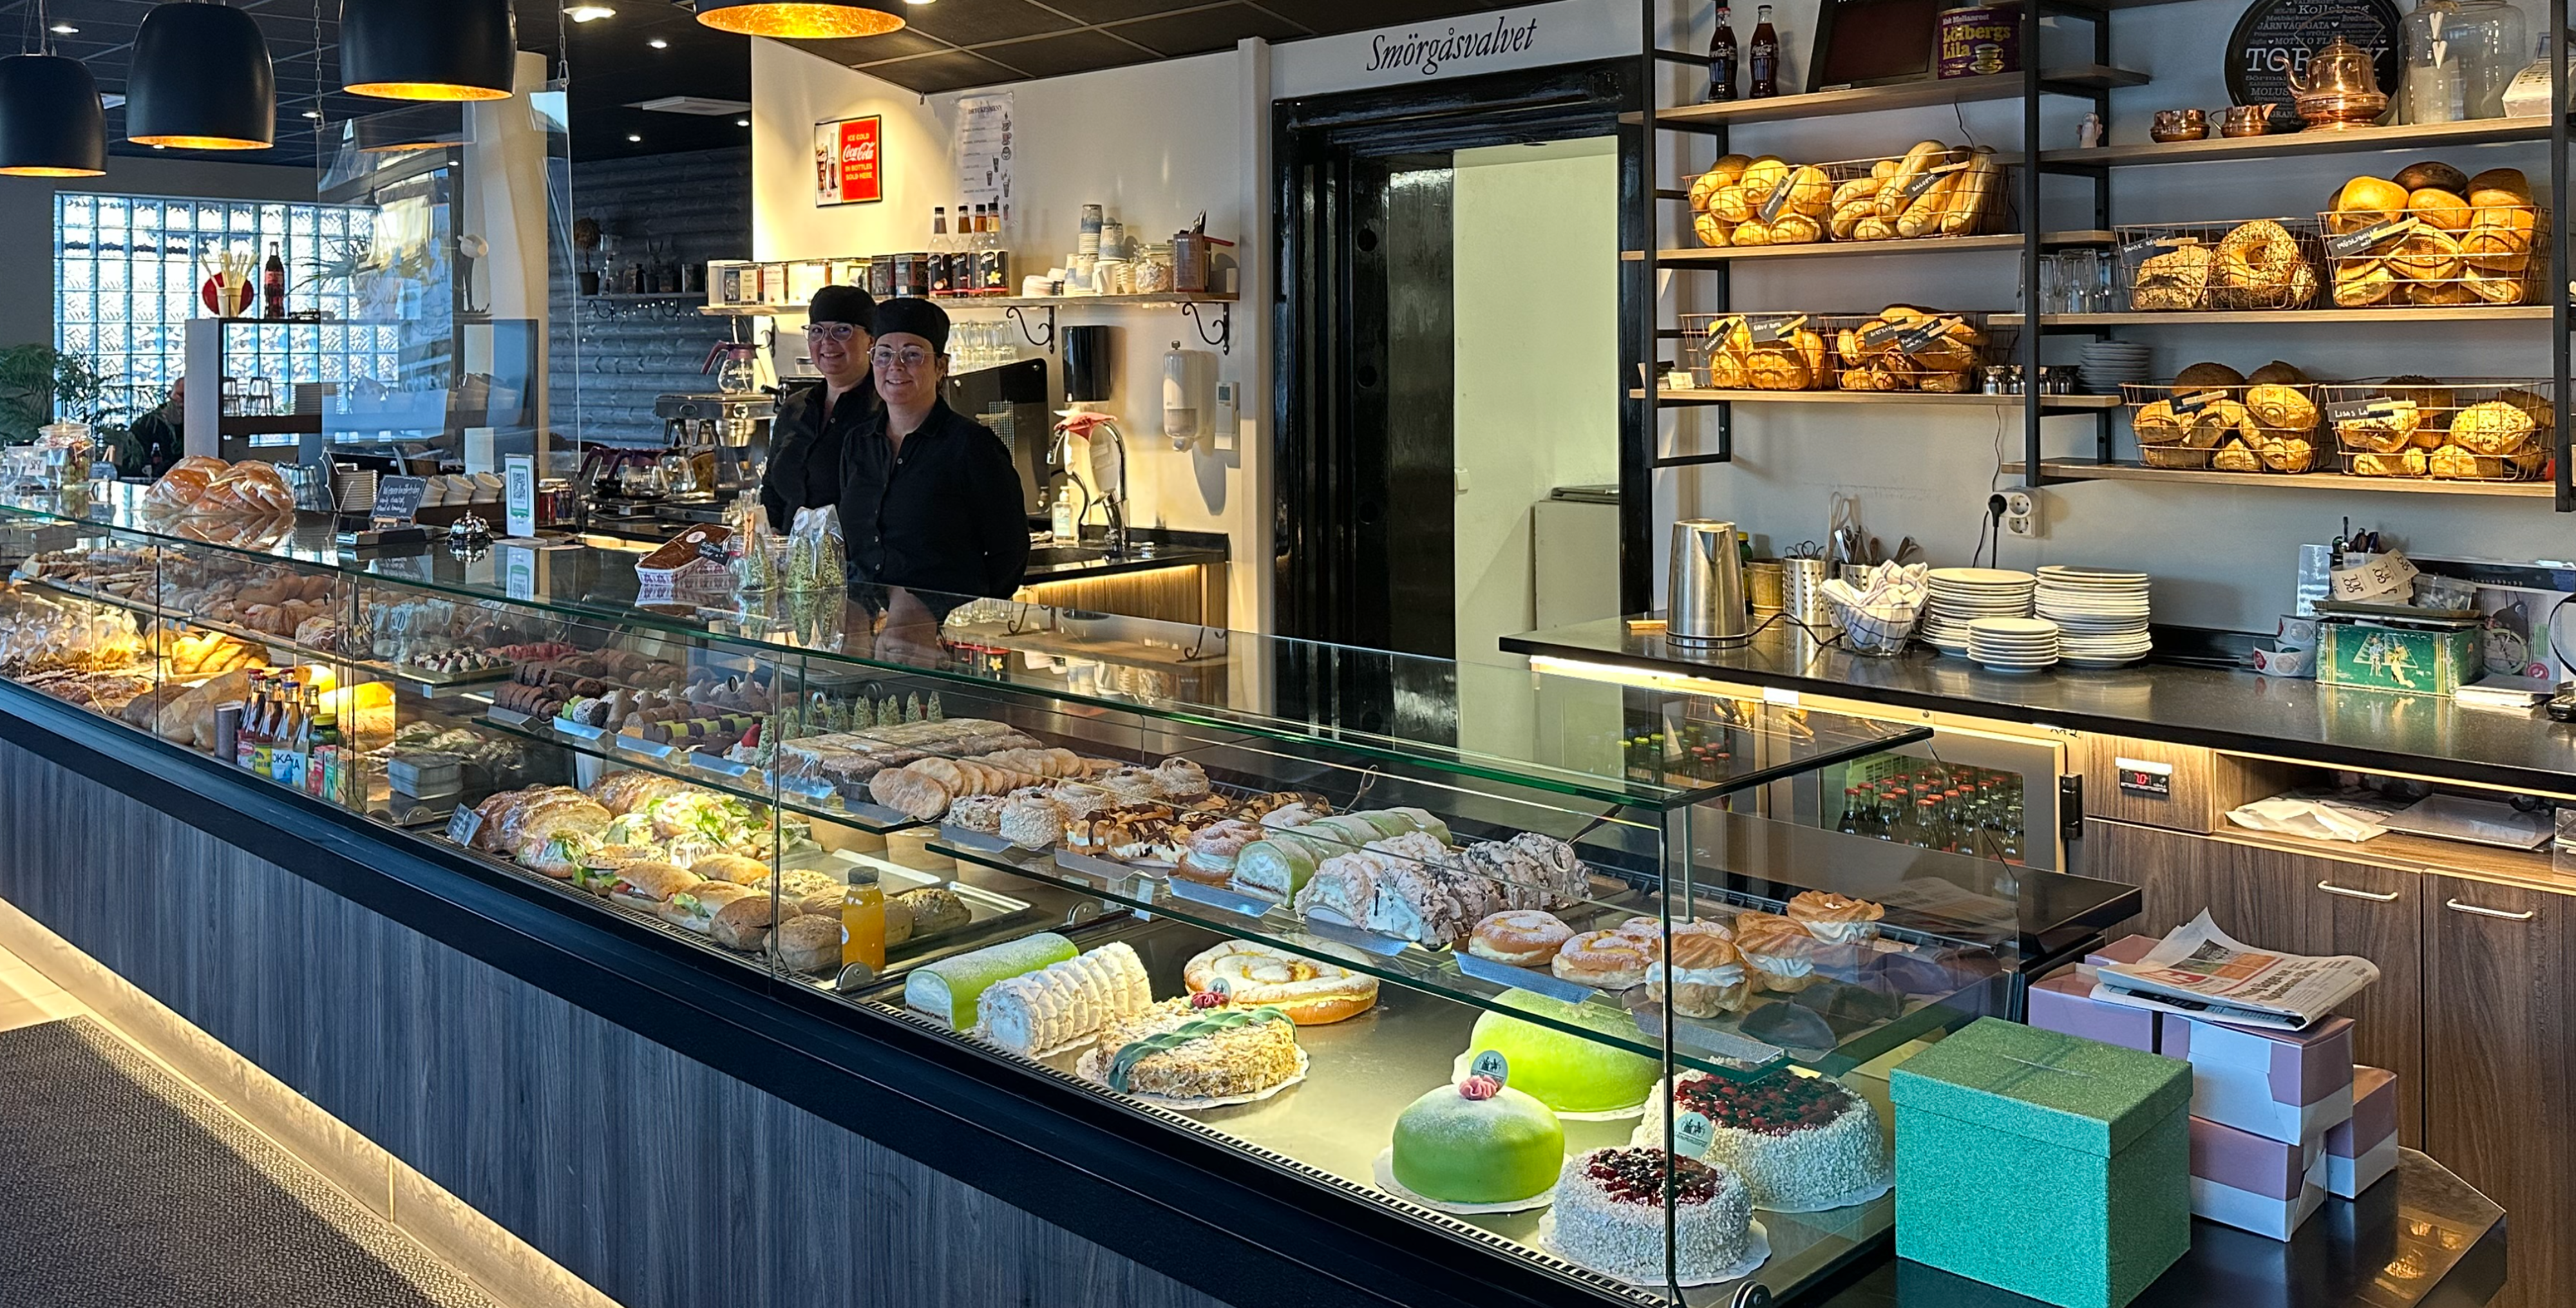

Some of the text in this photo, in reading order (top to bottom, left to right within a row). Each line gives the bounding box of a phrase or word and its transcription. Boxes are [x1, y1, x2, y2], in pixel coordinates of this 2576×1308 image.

[1943, 24, 2011, 43] Löfbergs
[1366, 16, 1537, 75] Smörgåsvalvet
[1943, 41, 1970, 60] Lila
[2246, 48, 2389, 72] TORY
[273, 754, 293, 764] OKA
